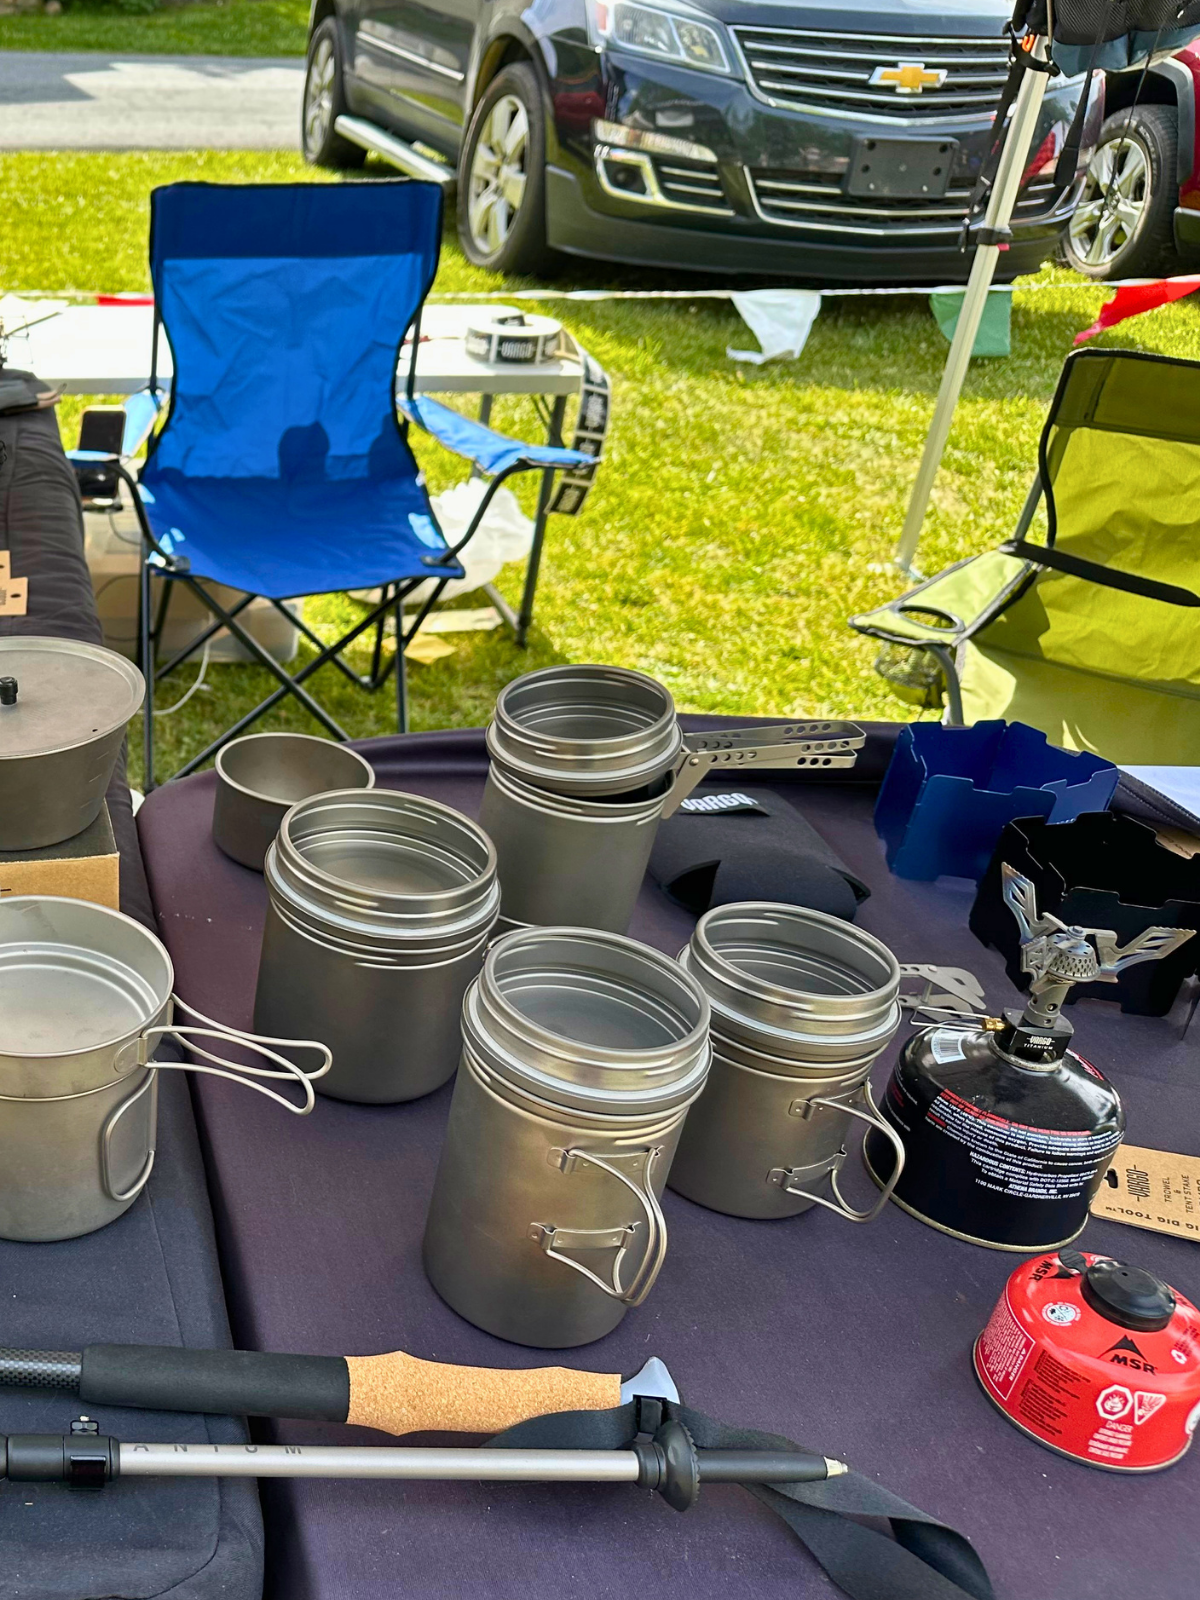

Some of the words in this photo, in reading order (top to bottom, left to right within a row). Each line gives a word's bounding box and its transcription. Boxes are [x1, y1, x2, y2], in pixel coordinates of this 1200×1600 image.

[680, 792, 754, 811] VARGO
[971, 1138, 988, 1149] known
[1023, 1156, 1048, 1165] California
[975, 1146, 1005, 1160] combustion
[970, 1151, 999, 1166] HAZARDOUS
[999, 1162, 1027, 1174] CONTENTS:
[1026, 1170, 1058, 1178] Hydrocarbon
[971, 1157, 982, 1166] This
[982, 1163, 1005, 1174] cartridge
[1005, 1171, 1028, 1180] complies
[987, 1171, 1004, 1180] obtain
[1009, 1177, 1029, 1186] Material
[987, 1183, 1004, 1192] MARK
[1126, 1168, 1151, 1198] VARGO
[1162, 1176, 1173, 1203] TROWEL
[1181, 1174, 1192, 1195] STAKE
[1184, 1197, 1194, 1214] TENT
[1157, 1216, 1180, 1227] DIG
[1028, 1260, 1053, 1283] MSR
[1008, 1354, 1025, 1382] DANGER
[1110, 1353, 1157, 1376] MSR
[1105, 1420, 1134, 1433] DANGER
